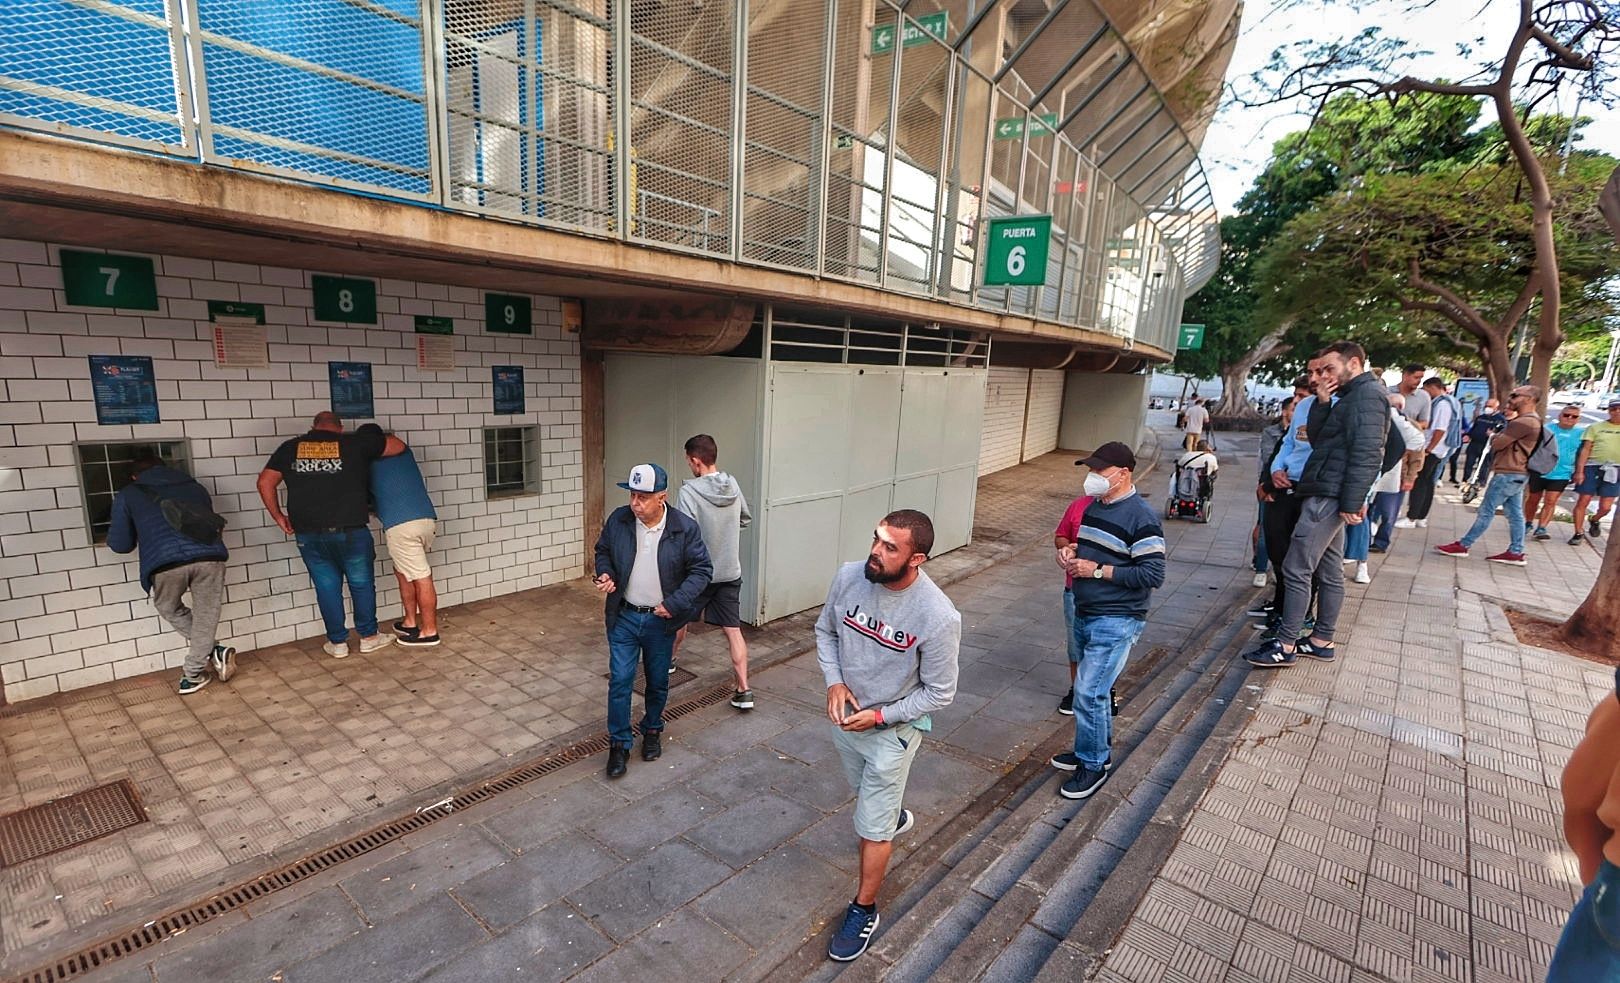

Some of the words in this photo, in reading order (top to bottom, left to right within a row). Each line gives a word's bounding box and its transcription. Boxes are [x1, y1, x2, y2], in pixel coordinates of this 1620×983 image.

[1002, 227, 1036, 239] PUERTA
[1006, 245, 1027, 277] 6
[98, 266, 121, 297] 7
[338, 288, 354, 313] 8
[504, 304, 516, 325] 9
[1186, 334, 1196, 347] 7
[845, 604, 918, 650] Journey
